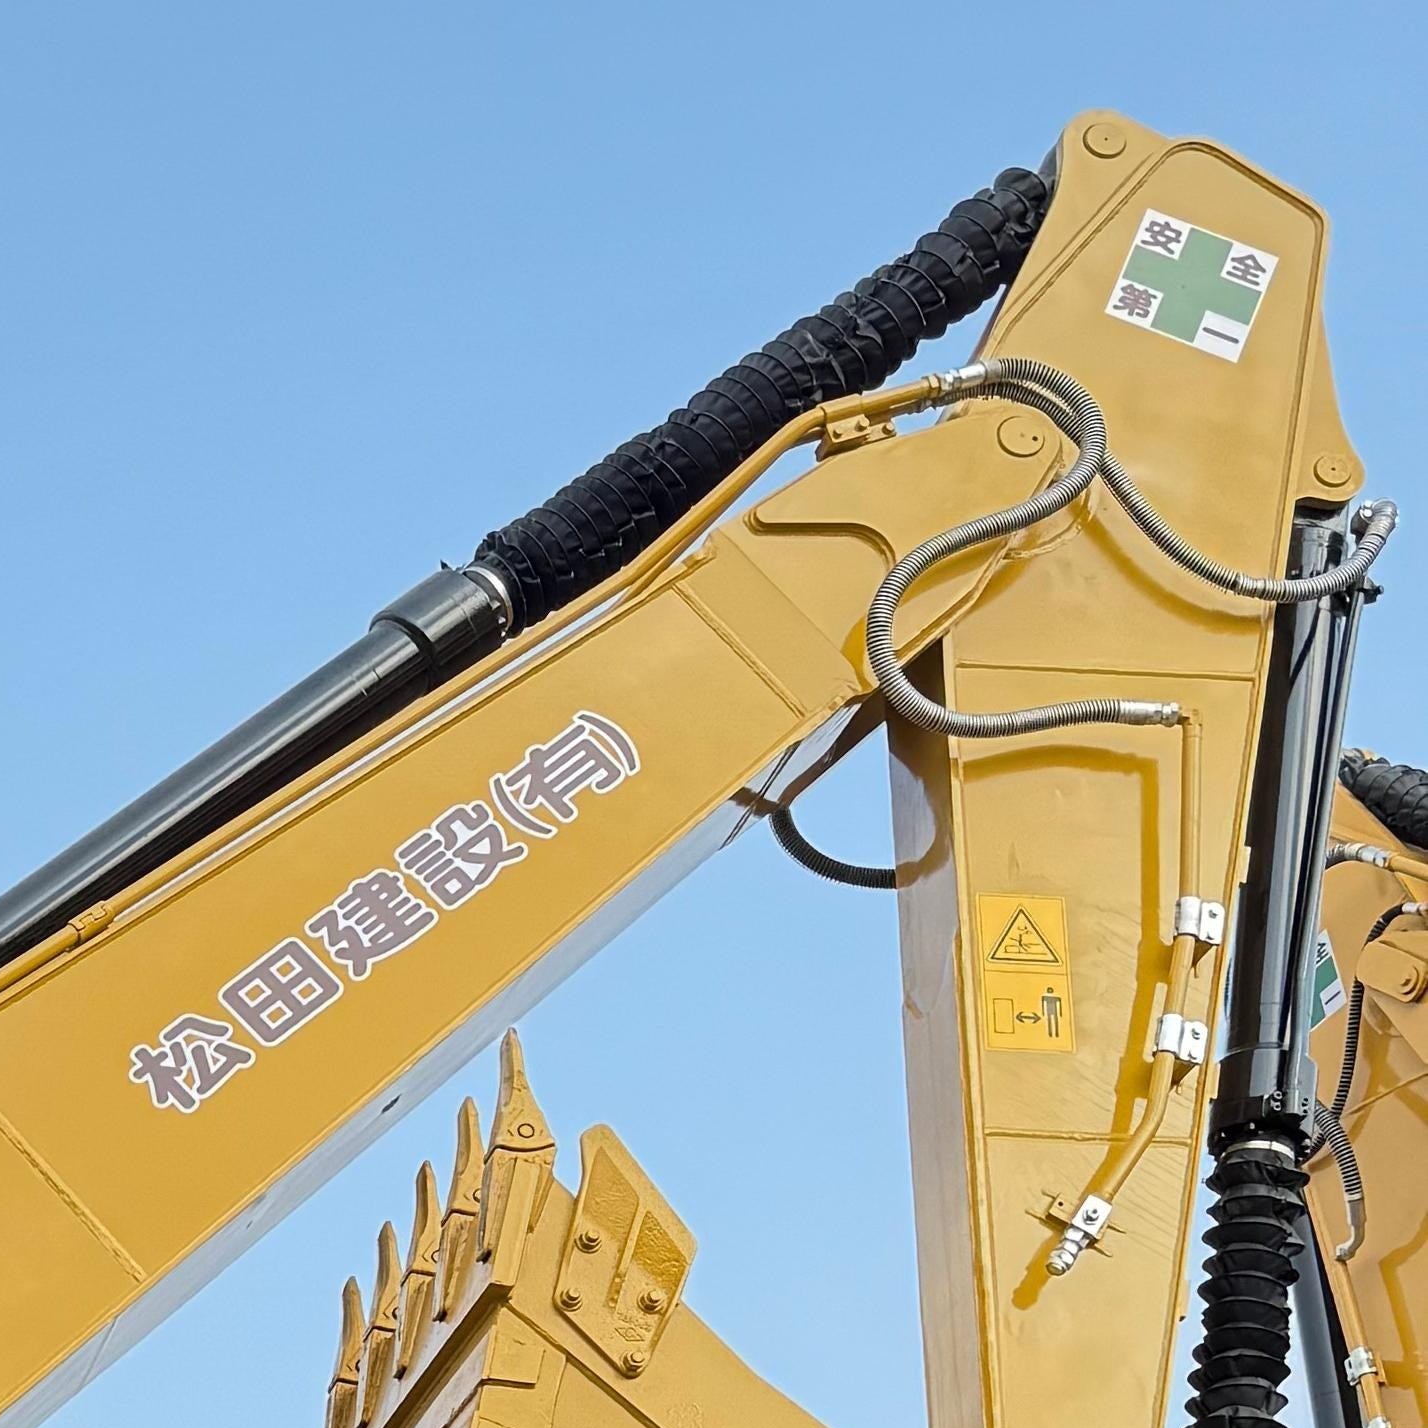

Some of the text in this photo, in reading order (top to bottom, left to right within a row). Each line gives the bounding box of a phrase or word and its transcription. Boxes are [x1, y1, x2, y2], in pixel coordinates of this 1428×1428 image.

[129, 710, 641, 1114] 松田建設(有)
